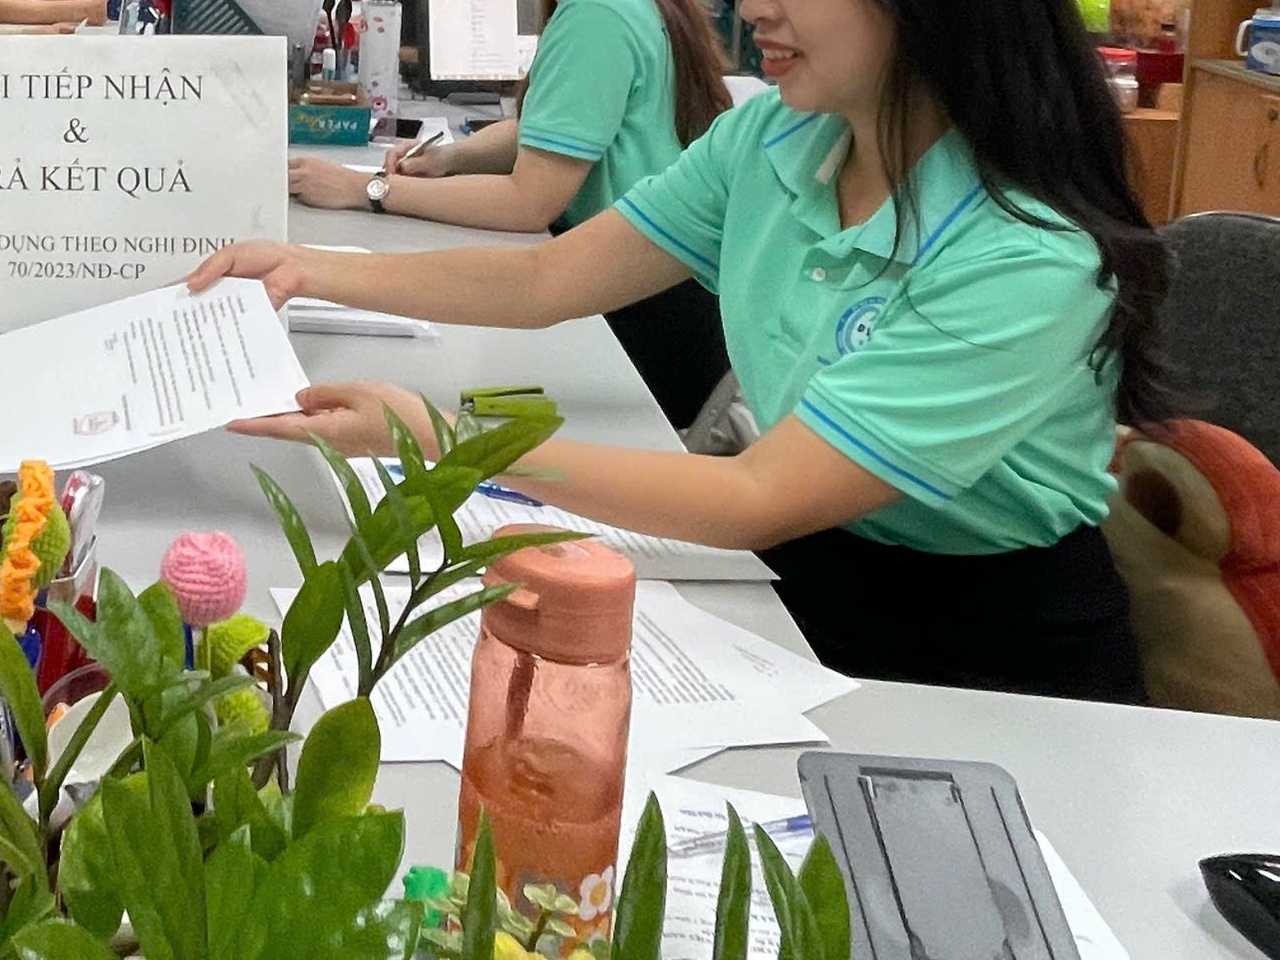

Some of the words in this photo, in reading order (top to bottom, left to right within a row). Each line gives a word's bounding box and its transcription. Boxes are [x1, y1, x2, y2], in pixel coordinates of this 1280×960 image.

[20, 66, 93, 100] TIẾP
[104, 67, 203, 106] NHẬN
[63, 117, 89, 143] &
[40, 158, 107, 192] KẾT
[116, 159, 193, 198] QUẢ
[61, 235, 117, 253] THEO
[124, 236, 175, 255] NGHỊ
[7, 260, 146, 280] 70/2023/NĐ-CP
